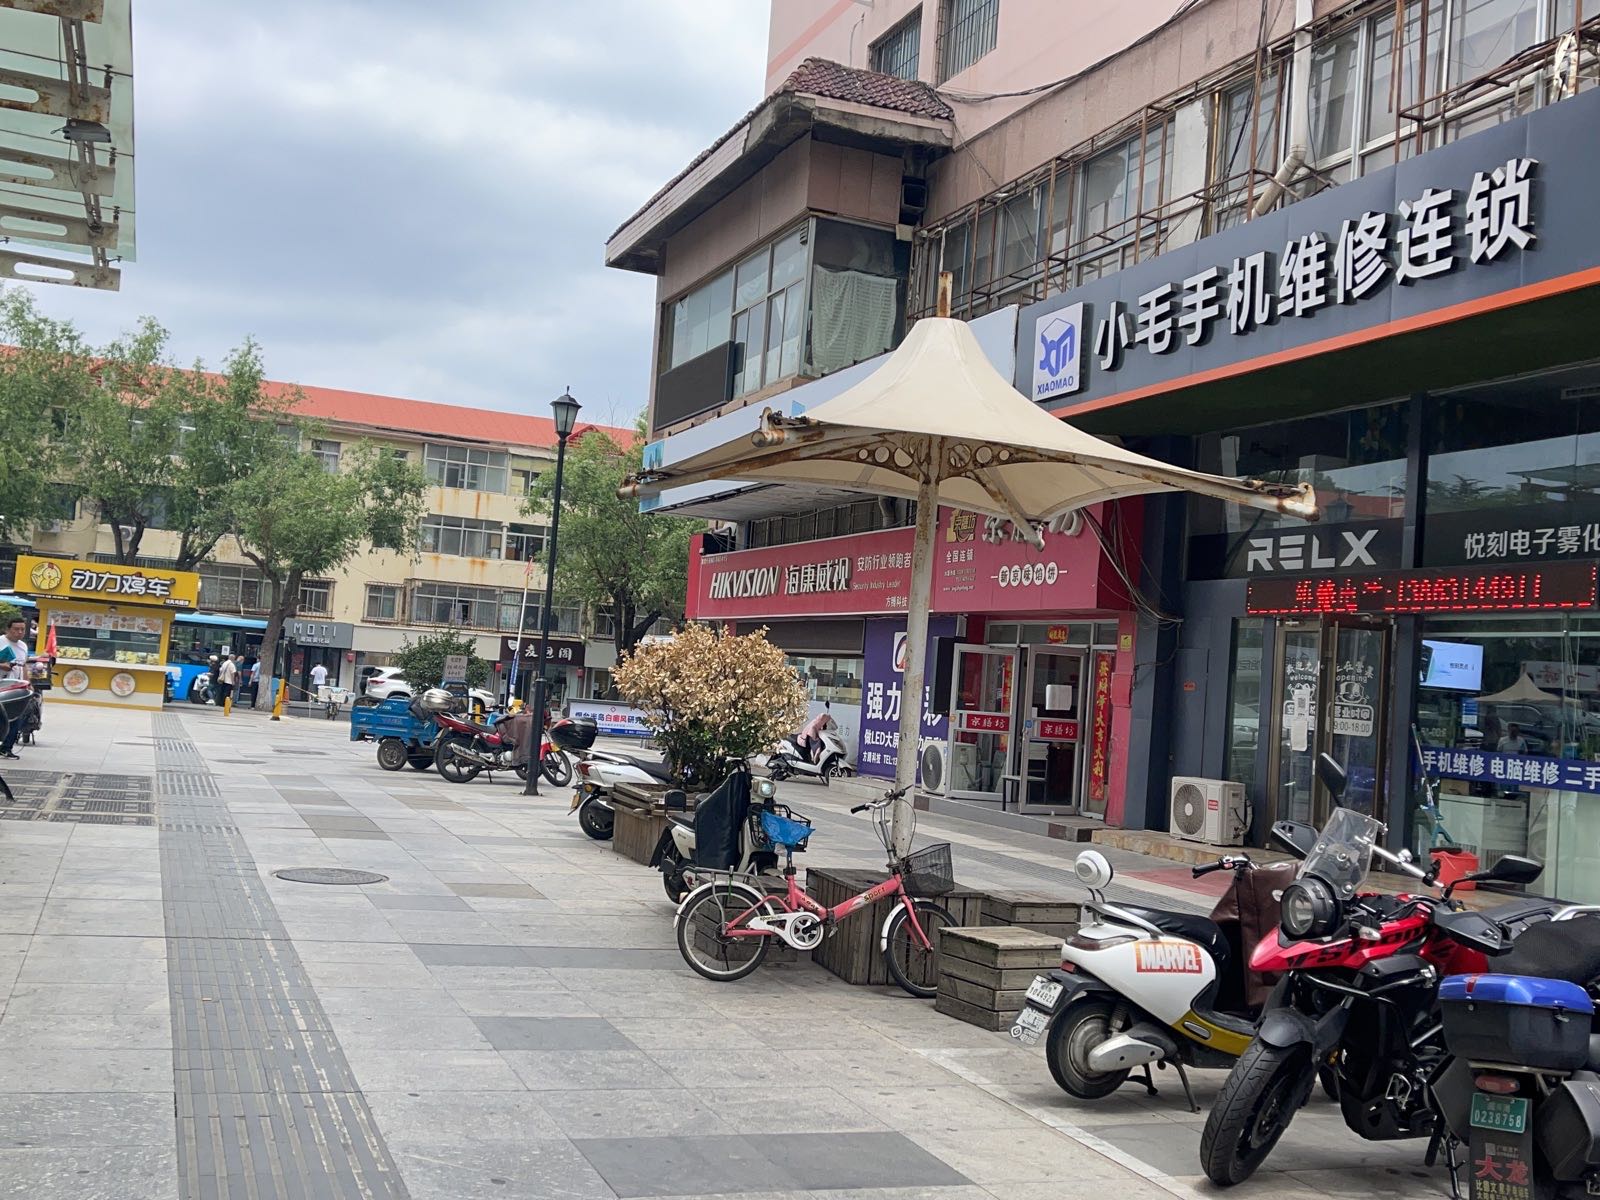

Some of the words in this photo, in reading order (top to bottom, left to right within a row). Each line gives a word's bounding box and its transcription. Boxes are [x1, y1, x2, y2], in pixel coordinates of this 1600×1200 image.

[1094, 158, 1540, 371] 小毛手机维修连锁
[1037, 376, 1074, 395] XIAOMAO
[1247, 529, 1380, 572] RELX
[1465, 523, 1600, 559] 悦刻电子雾化
[784, 557, 850, 595] 海康威视
[857, 551, 912, 572] 安防行业领跑者
[70, 569, 172, 598] 动力鸡车
[709, 565, 781, 599] HIKVISION
[293, 622, 337, 637] MOTI
[1422, 751, 1485, 777] 手机维修
[1490, 757, 1560, 785] 电脑维修
[1138, 943, 1201, 972] MARVEL
[1029, 986, 1056, 1004] 1044922
[1474, 1109, 1522, 1128] 0238758
